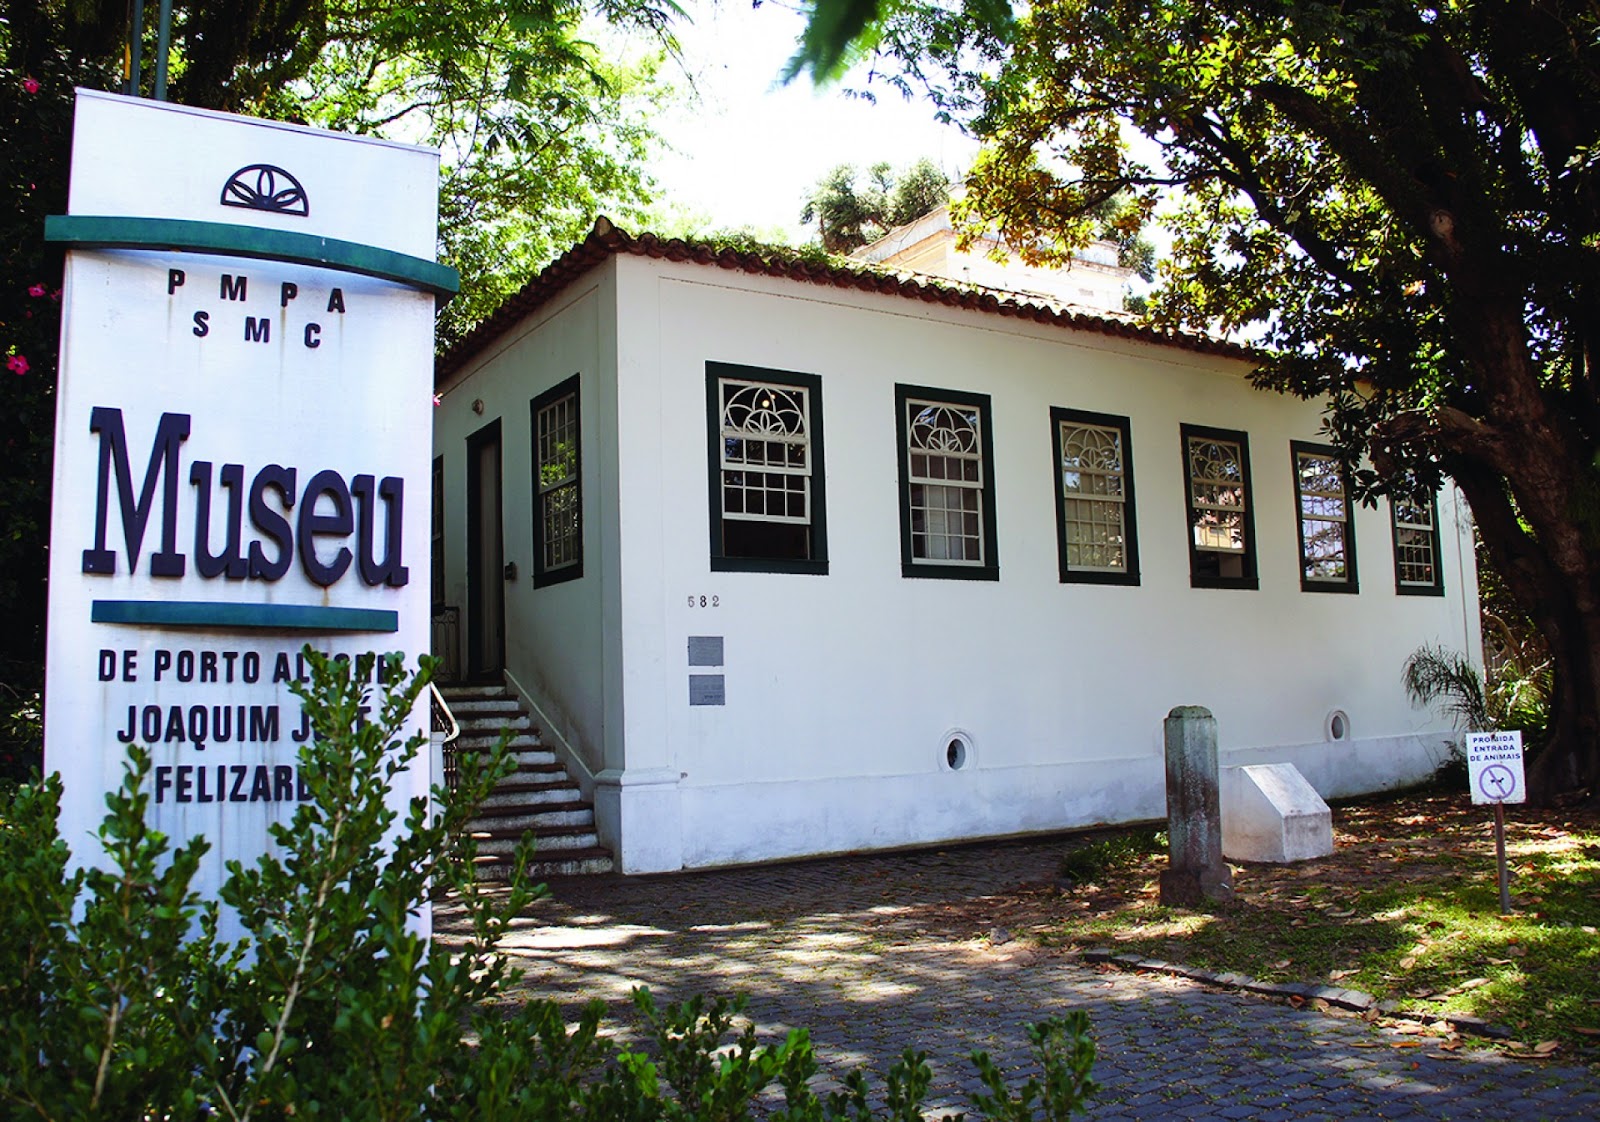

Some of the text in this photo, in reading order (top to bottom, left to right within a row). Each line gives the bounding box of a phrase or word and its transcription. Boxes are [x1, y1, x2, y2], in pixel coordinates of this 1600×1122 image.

[82, 406, 409, 587] Museu
[687, 595, 720, 608] 582
[98, 649, 138, 682] DE
[154, 650, 260, 684] PORTO
[117, 705, 280, 751] JOAQUIM
[1474, 744, 1515, 752] ENTRADA
[1483, 753, 1521, 761] ANIMAIS
